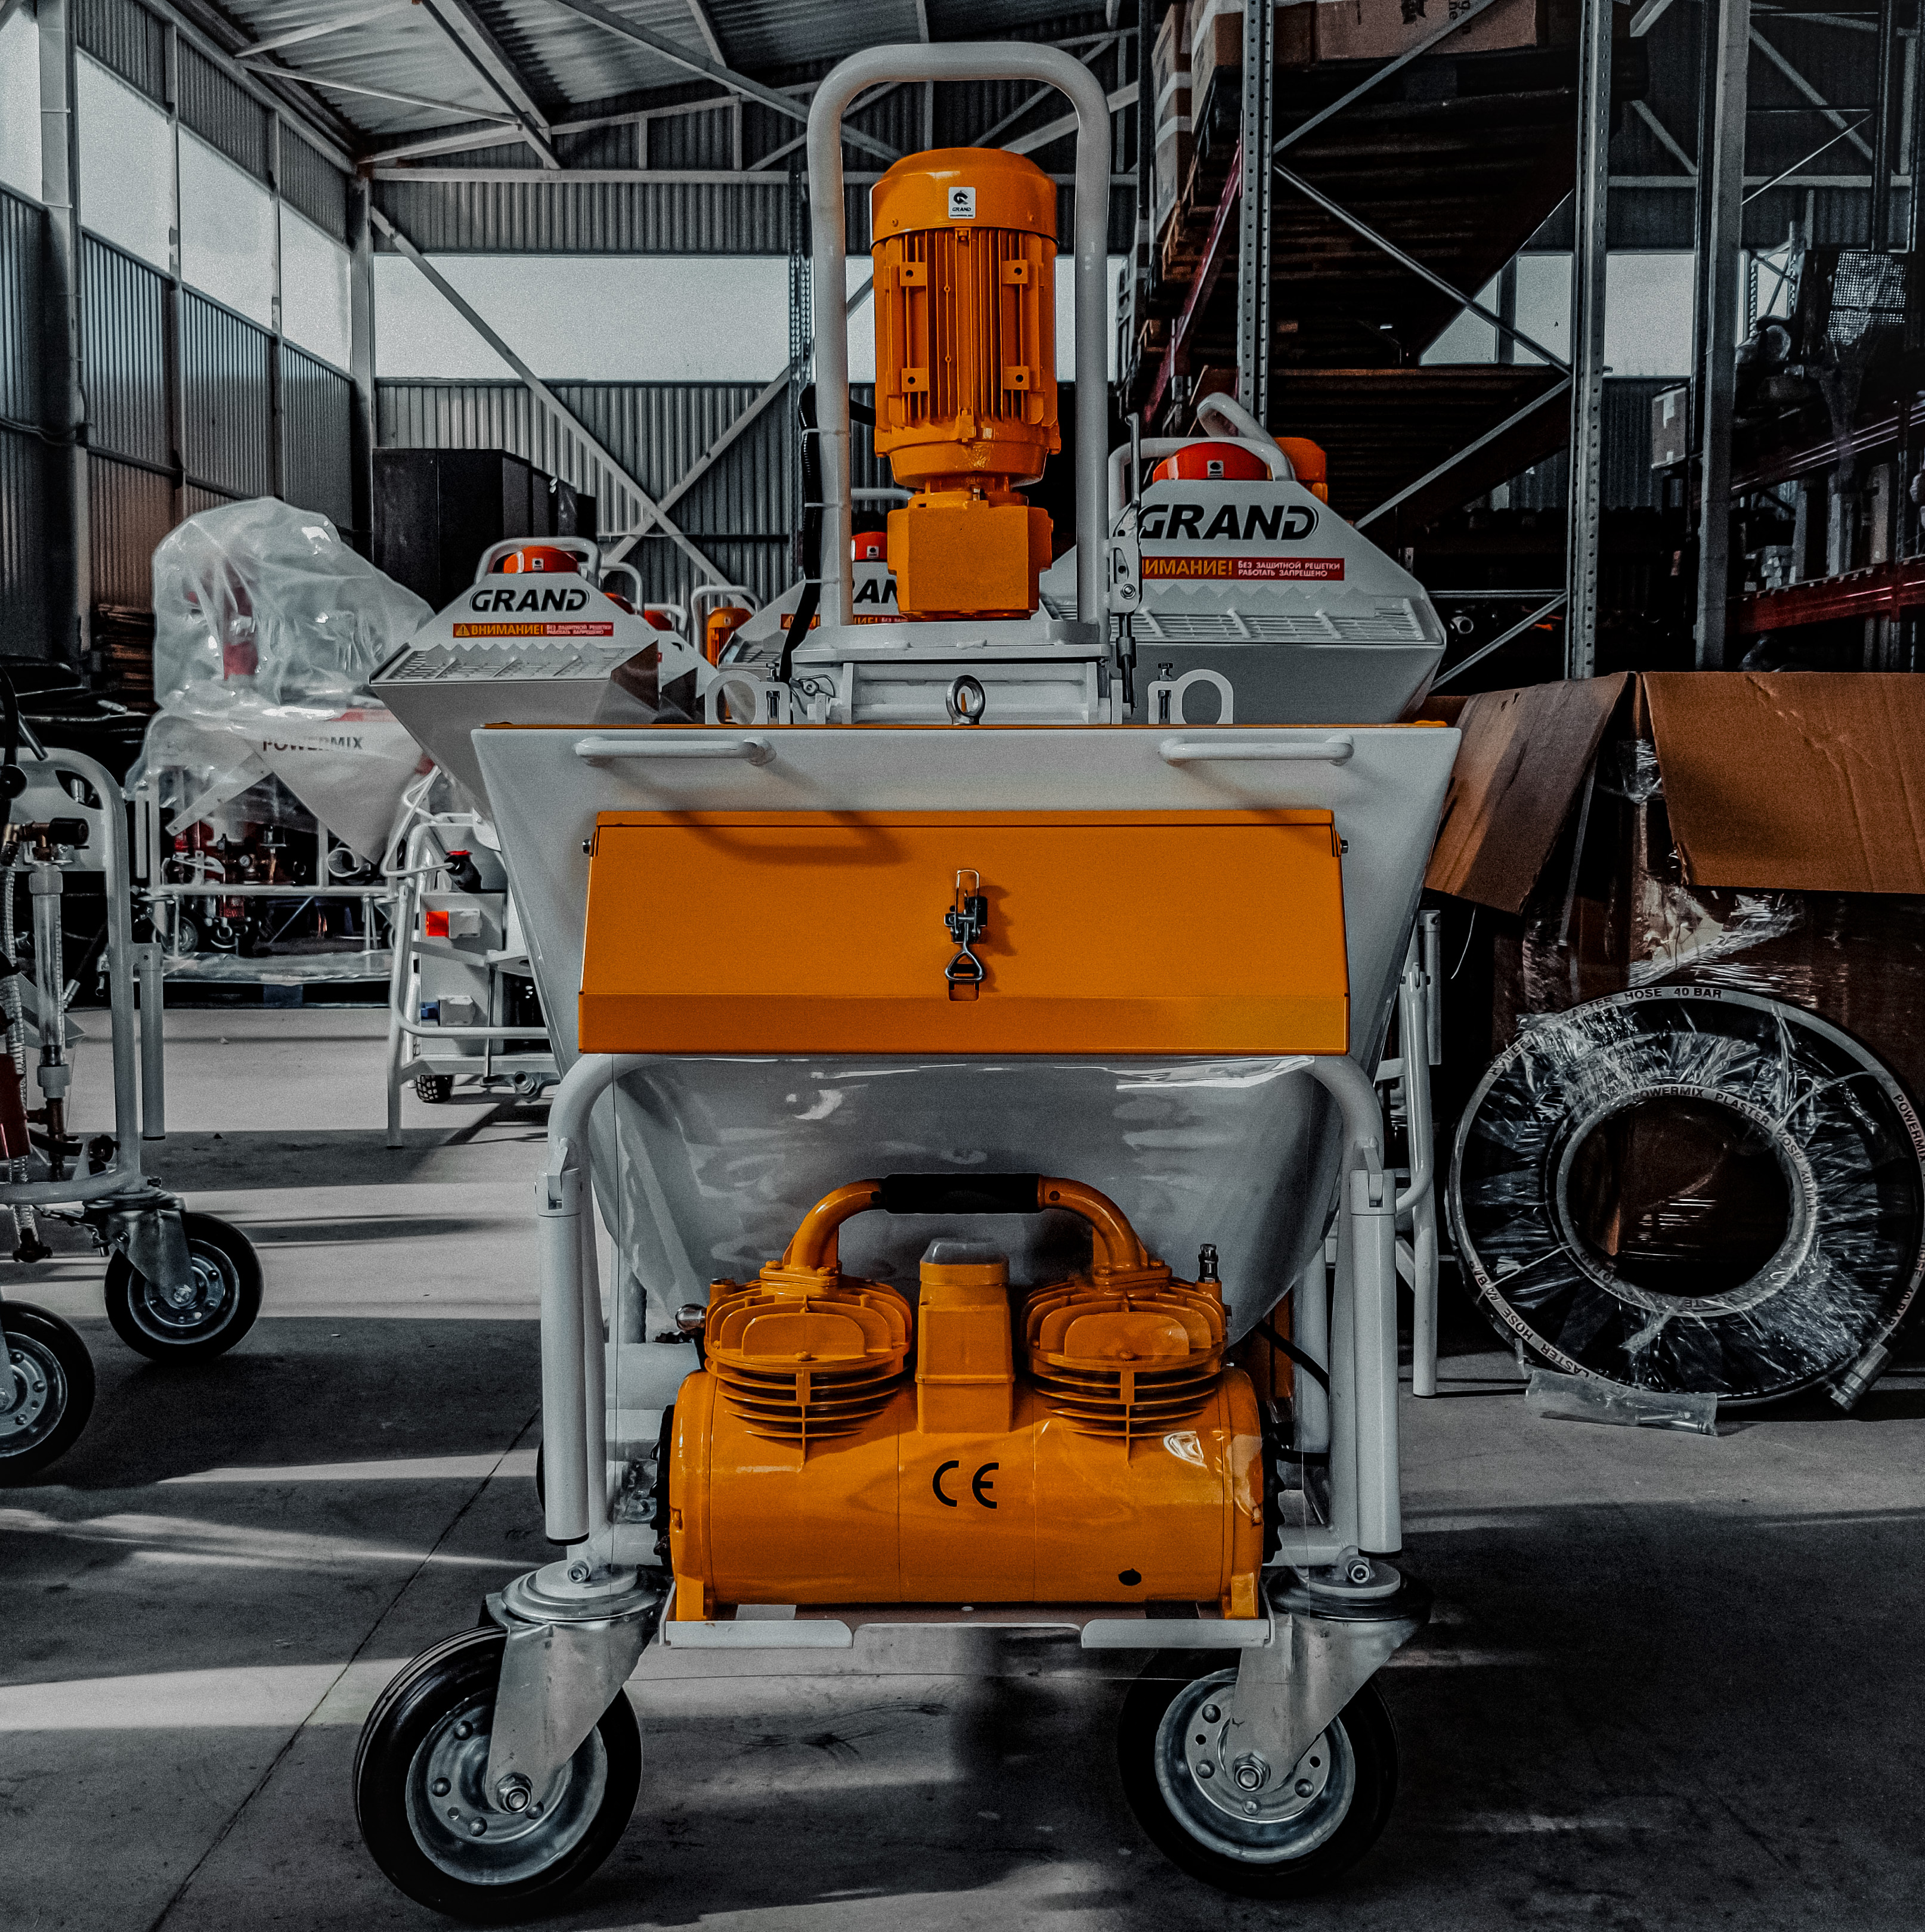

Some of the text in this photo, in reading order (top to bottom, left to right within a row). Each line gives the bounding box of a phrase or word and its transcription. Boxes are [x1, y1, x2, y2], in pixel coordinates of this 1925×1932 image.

[1138, 504, 1319, 540] GRAND
[1142, 559, 1233, 575] ИМАНИЕ!
[469, 589, 590, 612] GRAND
[471, 624, 544, 636] ВНИМАНИЕ!
[263, 736, 363, 752] POMIX
[1624, 988, 1662, 1001] HOSE
[1673, 987, 1689, 996] 40
[1694, 987, 1722, 999] BAR
[1713, 1092, 1770, 1126] PLASTER
[1502, 1308, 1534, 1341] HOSE
[1540, 1343, 1598, 1379] LASTER
[933, 1460, 999, 1509] CE
